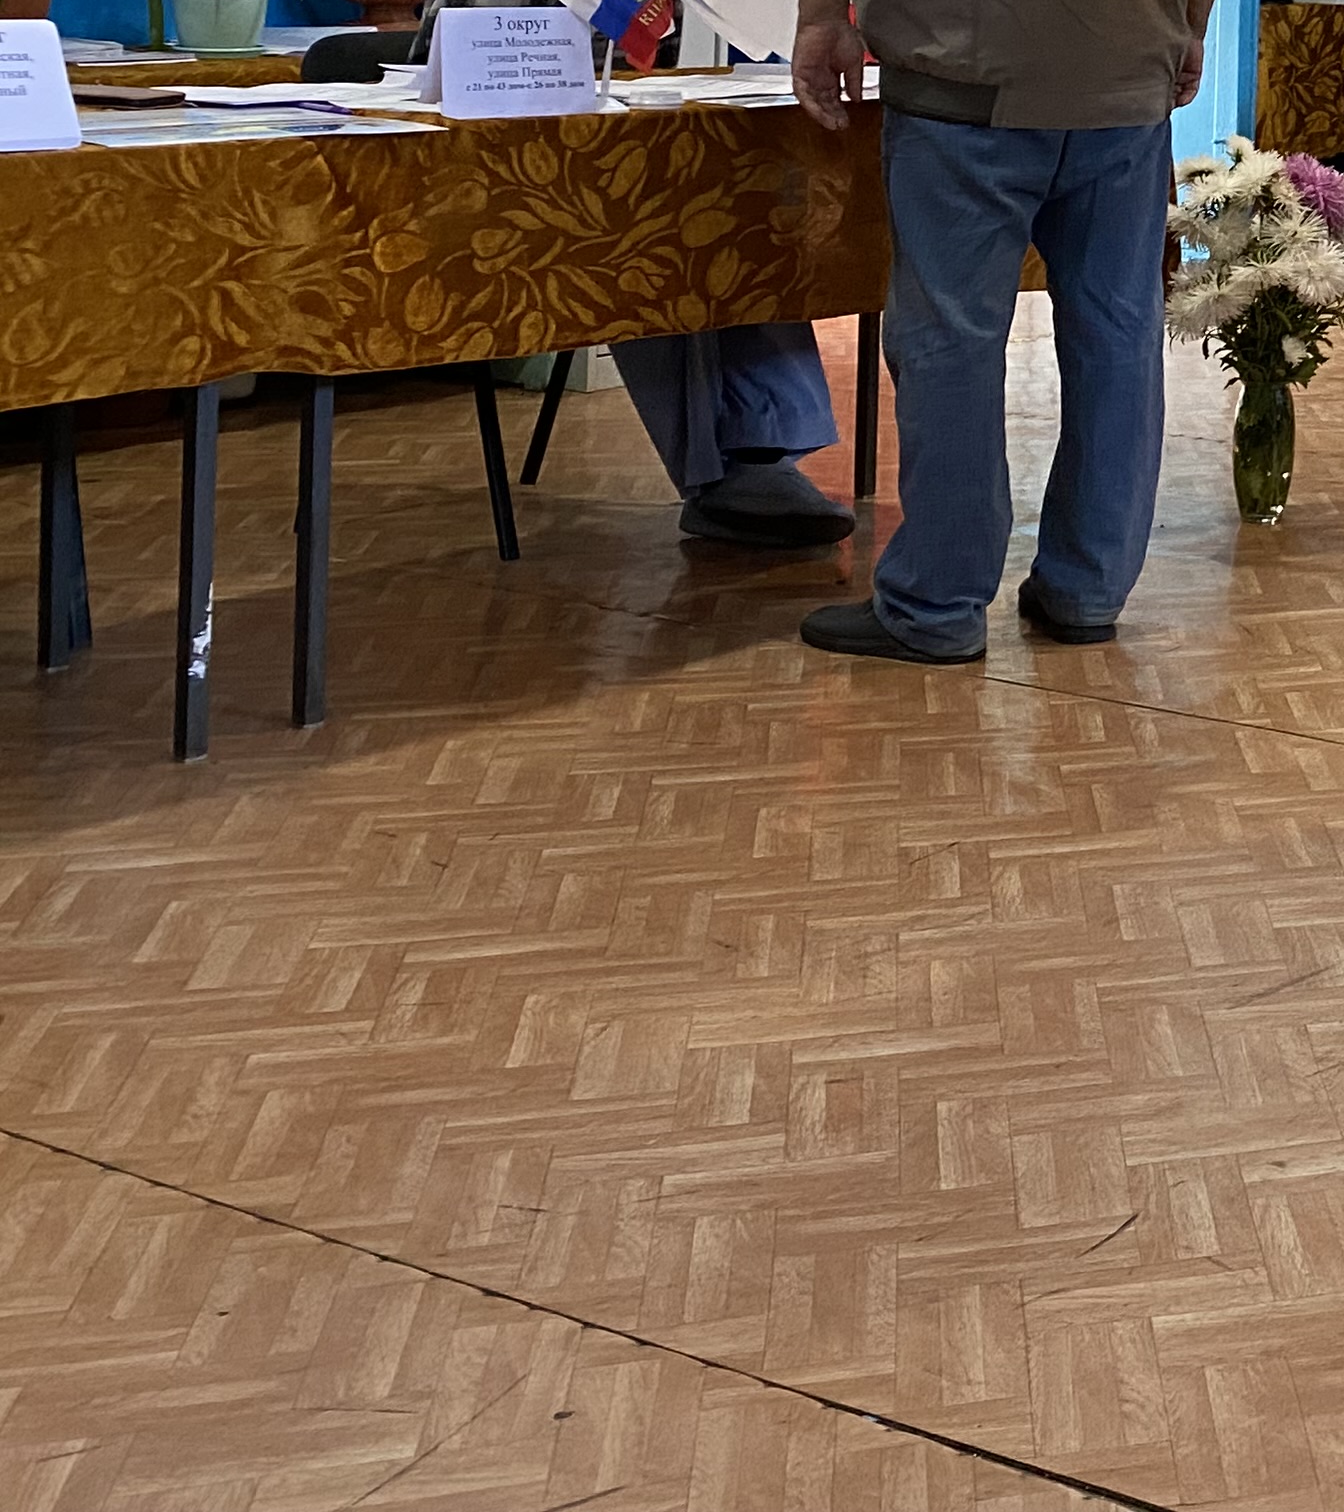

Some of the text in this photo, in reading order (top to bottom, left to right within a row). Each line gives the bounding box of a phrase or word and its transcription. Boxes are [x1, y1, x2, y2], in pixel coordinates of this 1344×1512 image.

[494, 16, 551, 35] 3 округ
[472, 37, 575, 51] улица Молодежная,
[487, 55, 518, 66] улица
[488, 67, 562, 81] улица Прямая
